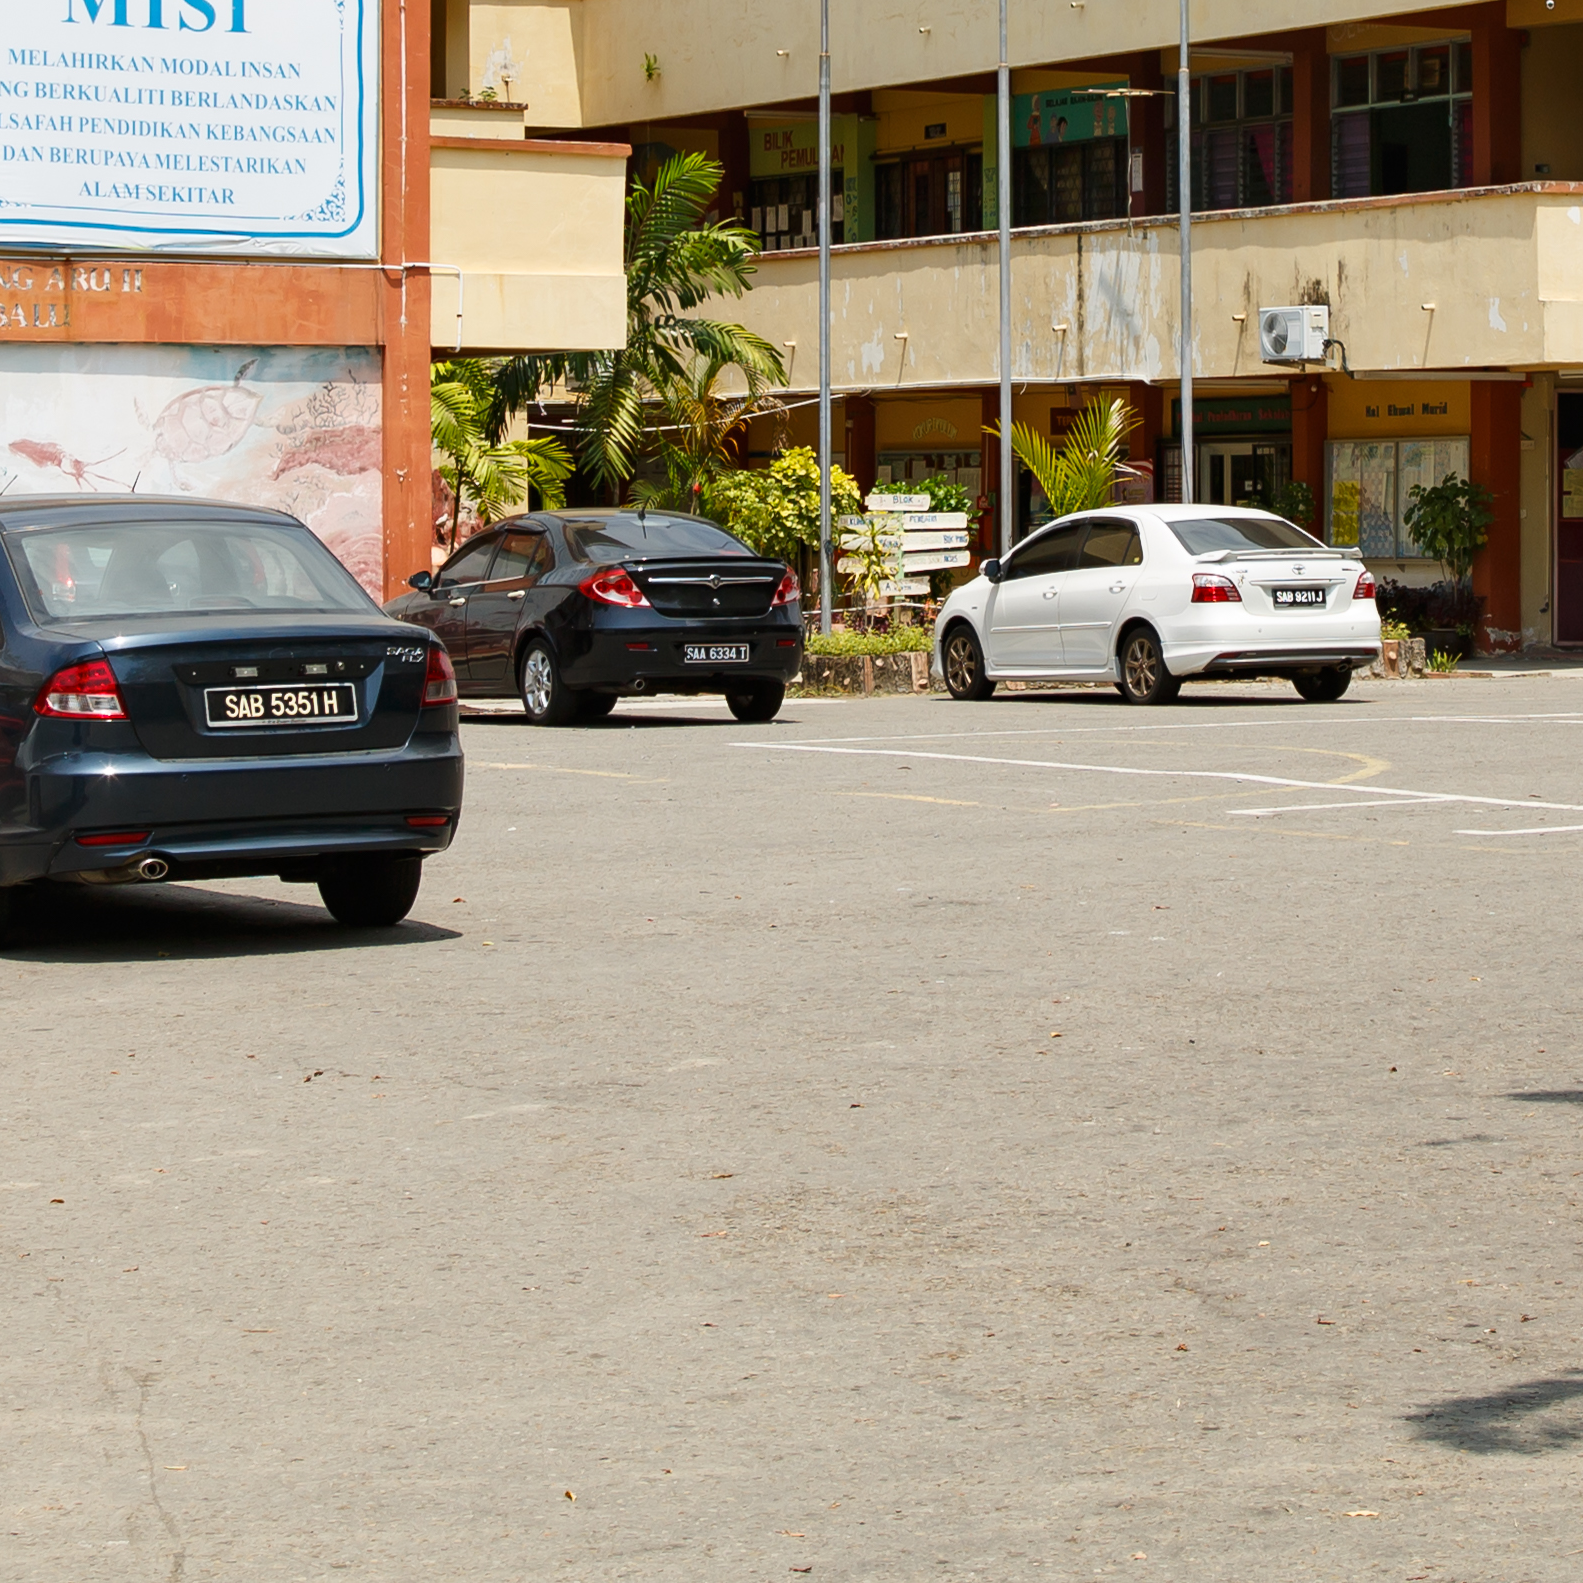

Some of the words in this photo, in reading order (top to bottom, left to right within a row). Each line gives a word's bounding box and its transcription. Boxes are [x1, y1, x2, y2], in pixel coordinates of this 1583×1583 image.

[9, 48, 154, 72] MELAHIRKAN
[161, 57, 237, 77] MODAL
[241, 61, 300, 79] INSAN
[35, 82, 164, 105] BERKUALITI
[171, 90, 335, 111] BERLANDASKAN
[79, 117, 200, 139] PENDIDIKAN
[206, 123, 335, 144] KEBANGSAAN
[764, 130, 794, 151] BILIK
[3, 145, 43, 162] DAN
[50, 147, 151, 169] BERUPAYA
[155, 153, 305, 174] MELESTARIKAN
[79, 181, 140, 200] ALAM
[146, 185, 234, 204] SEKITAR
[45, 266, 111, 293] ARU
[121, 269, 143, 294] II
[1387, 403, 1415, 417] Ehwal
[1421, 401, 1448, 415] Murid
[1276, 591, 1294, 603] SAB
[1295, 591, 1316, 603] 9211
[1316, 590, 1323, 602] J
[387, 647, 424, 656] SAGA
[687, 647, 706, 660] SAA
[709, 647, 736, 659] 6334
[739, 647, 746, 659] T
[225, 694, 264, 718] SAB
[271, 691, 319, 716] 5351
[323, 690, 338, 714] H
